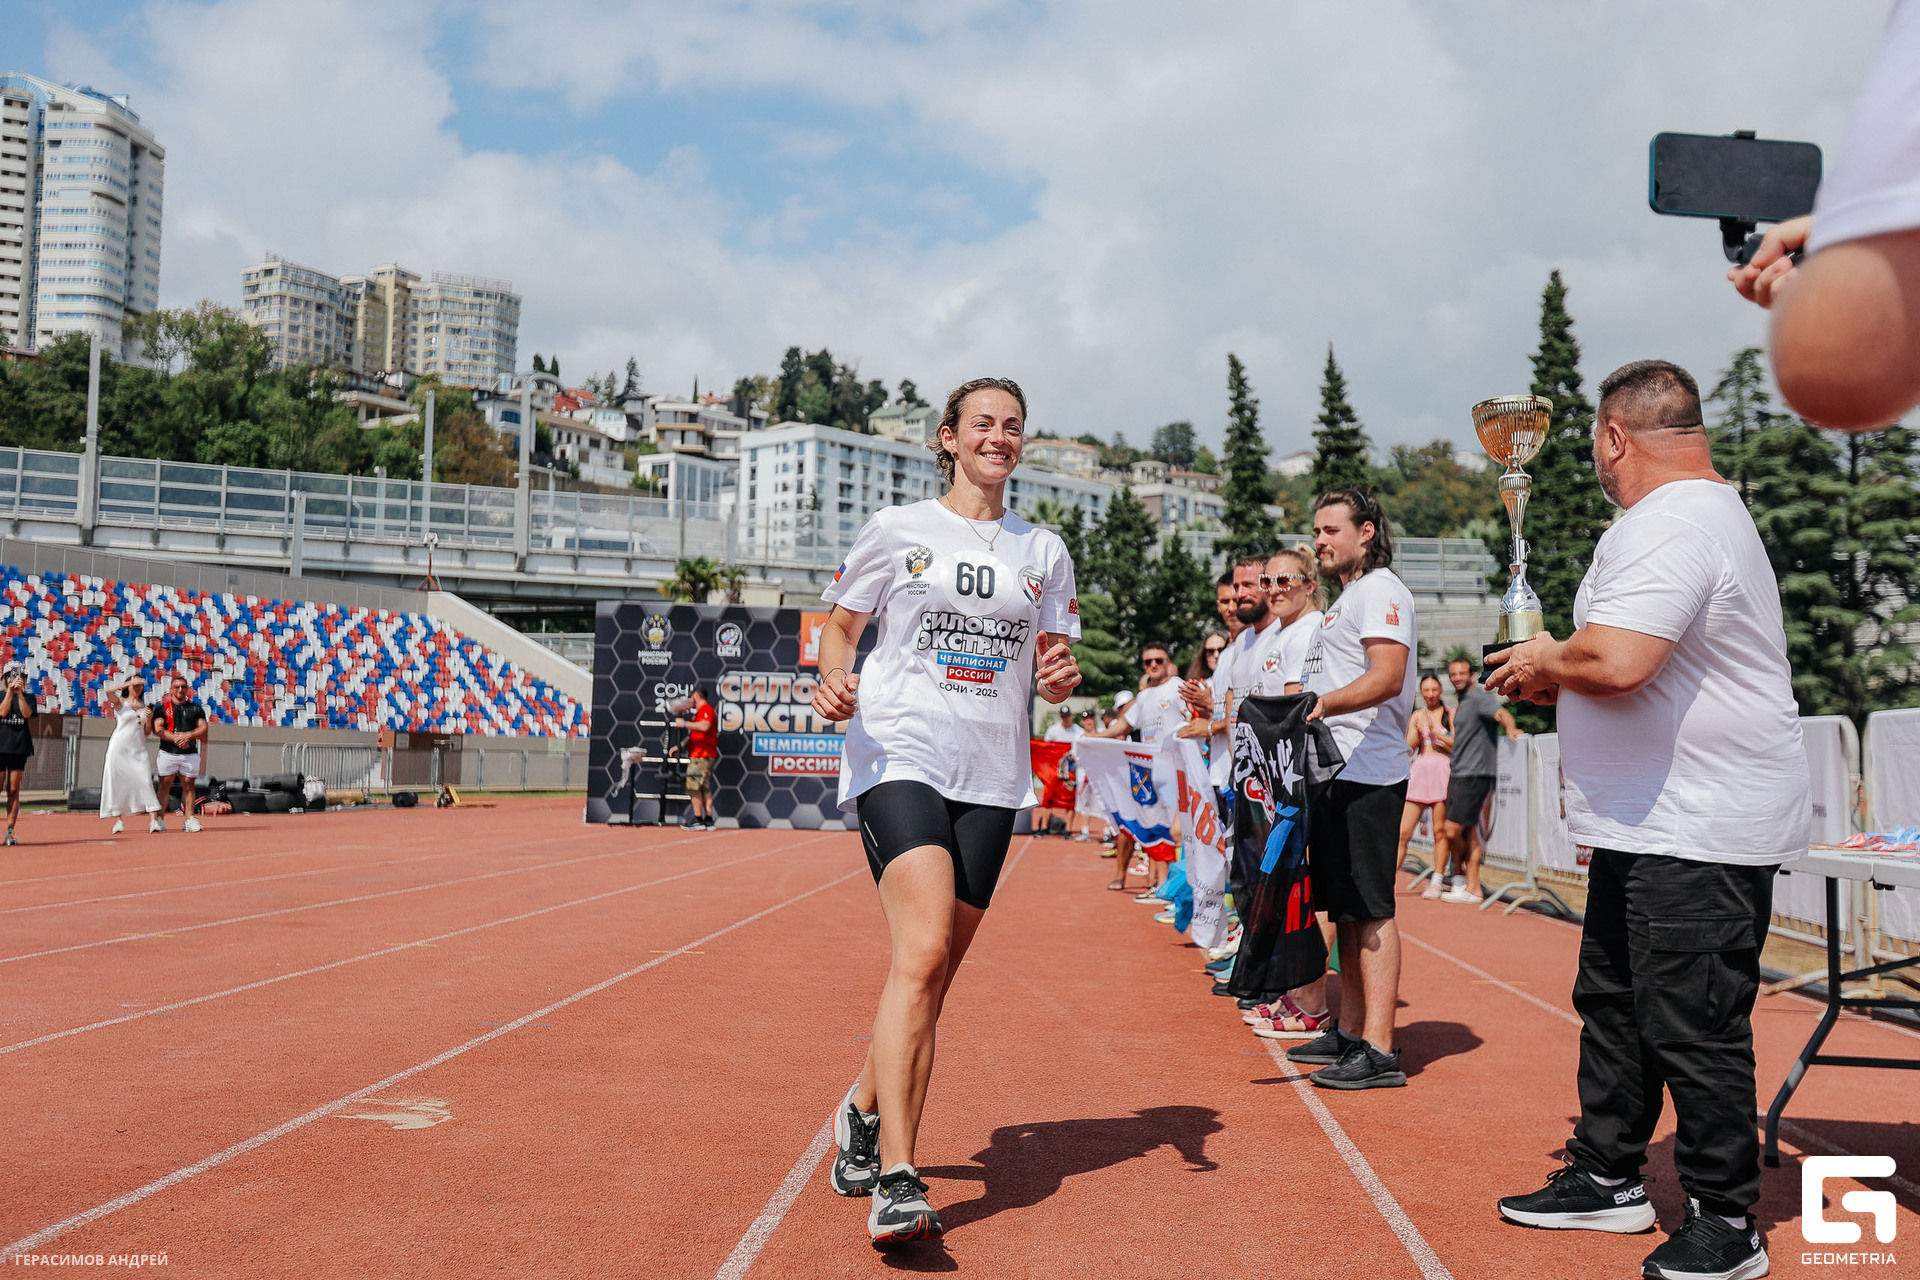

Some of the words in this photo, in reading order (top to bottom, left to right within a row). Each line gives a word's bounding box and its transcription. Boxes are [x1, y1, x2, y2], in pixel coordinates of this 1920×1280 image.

[956, 561, 996, 600] 60
[920, 611, 1030, 643] СИЛОВОЙ
[716, 645, 742, 658] ЦСП
[917, 630, 1023, 661] ЭКСТРИМ
[939, 654, 1005, 669] ЧЕМПИОНАТ
[948, 668, 992, 680] РОССИИ
[717, 671, 825, 704] СИЛО
[939, 682, 968, 694] СОЧИ
[975, 688, 998, 698] 2025
